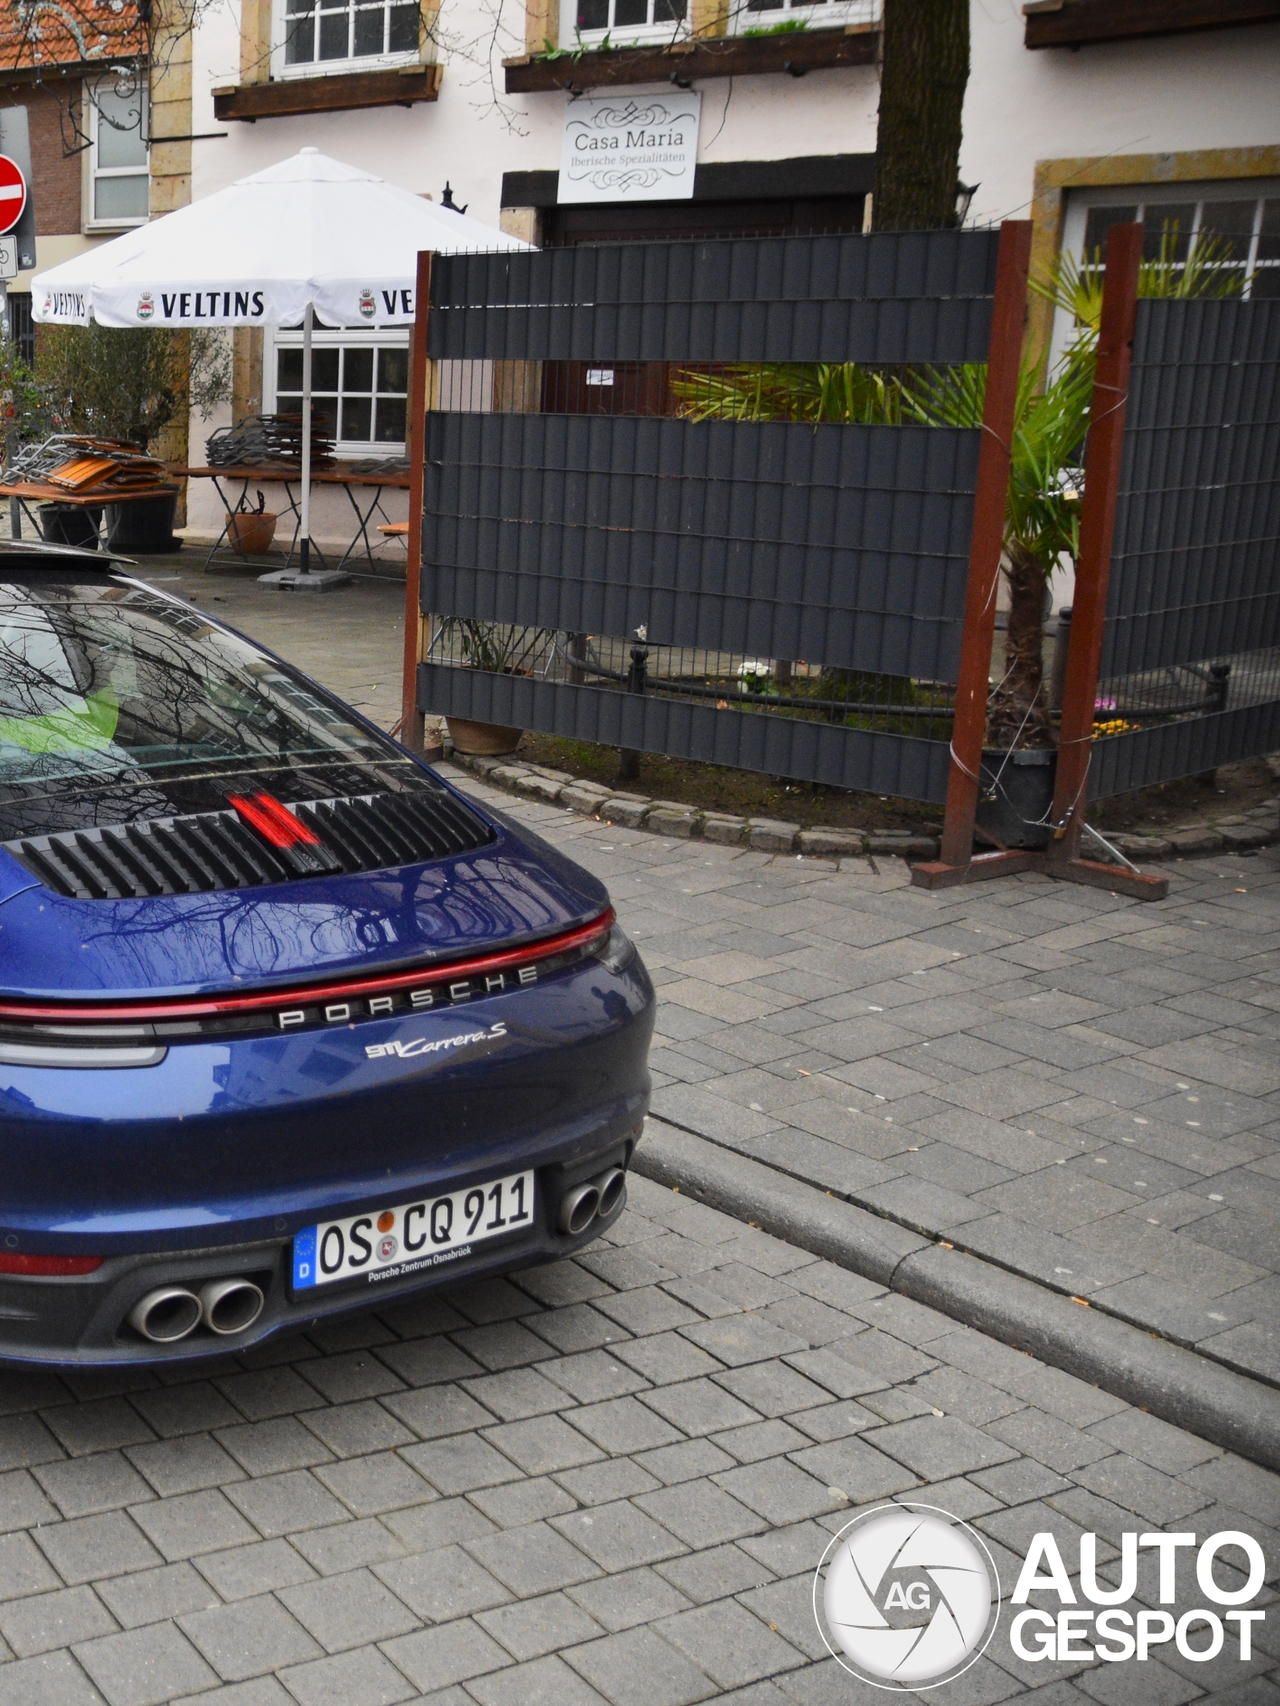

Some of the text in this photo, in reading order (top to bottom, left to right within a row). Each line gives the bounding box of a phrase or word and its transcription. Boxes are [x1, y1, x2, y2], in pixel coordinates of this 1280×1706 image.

[574, 128, 684, 151] Casa Maria
[570, 153, 686, 167] Iberische Spezialitäten
[53, 293, 85, 317] VELTINS
[161, 291, 264, 318] VELTINS
[278, 966, 538, 1029] PORSCHE
[398, 1037, 487, 1058] Carrera
[487, 1022, 508, 1040] S
[320, 1175, 529, 1275] OS CQ 911
[299, 1263, 309, 1279] D
[368, 1245, 472, 1282] Porsche Zentrum Osnabrück
